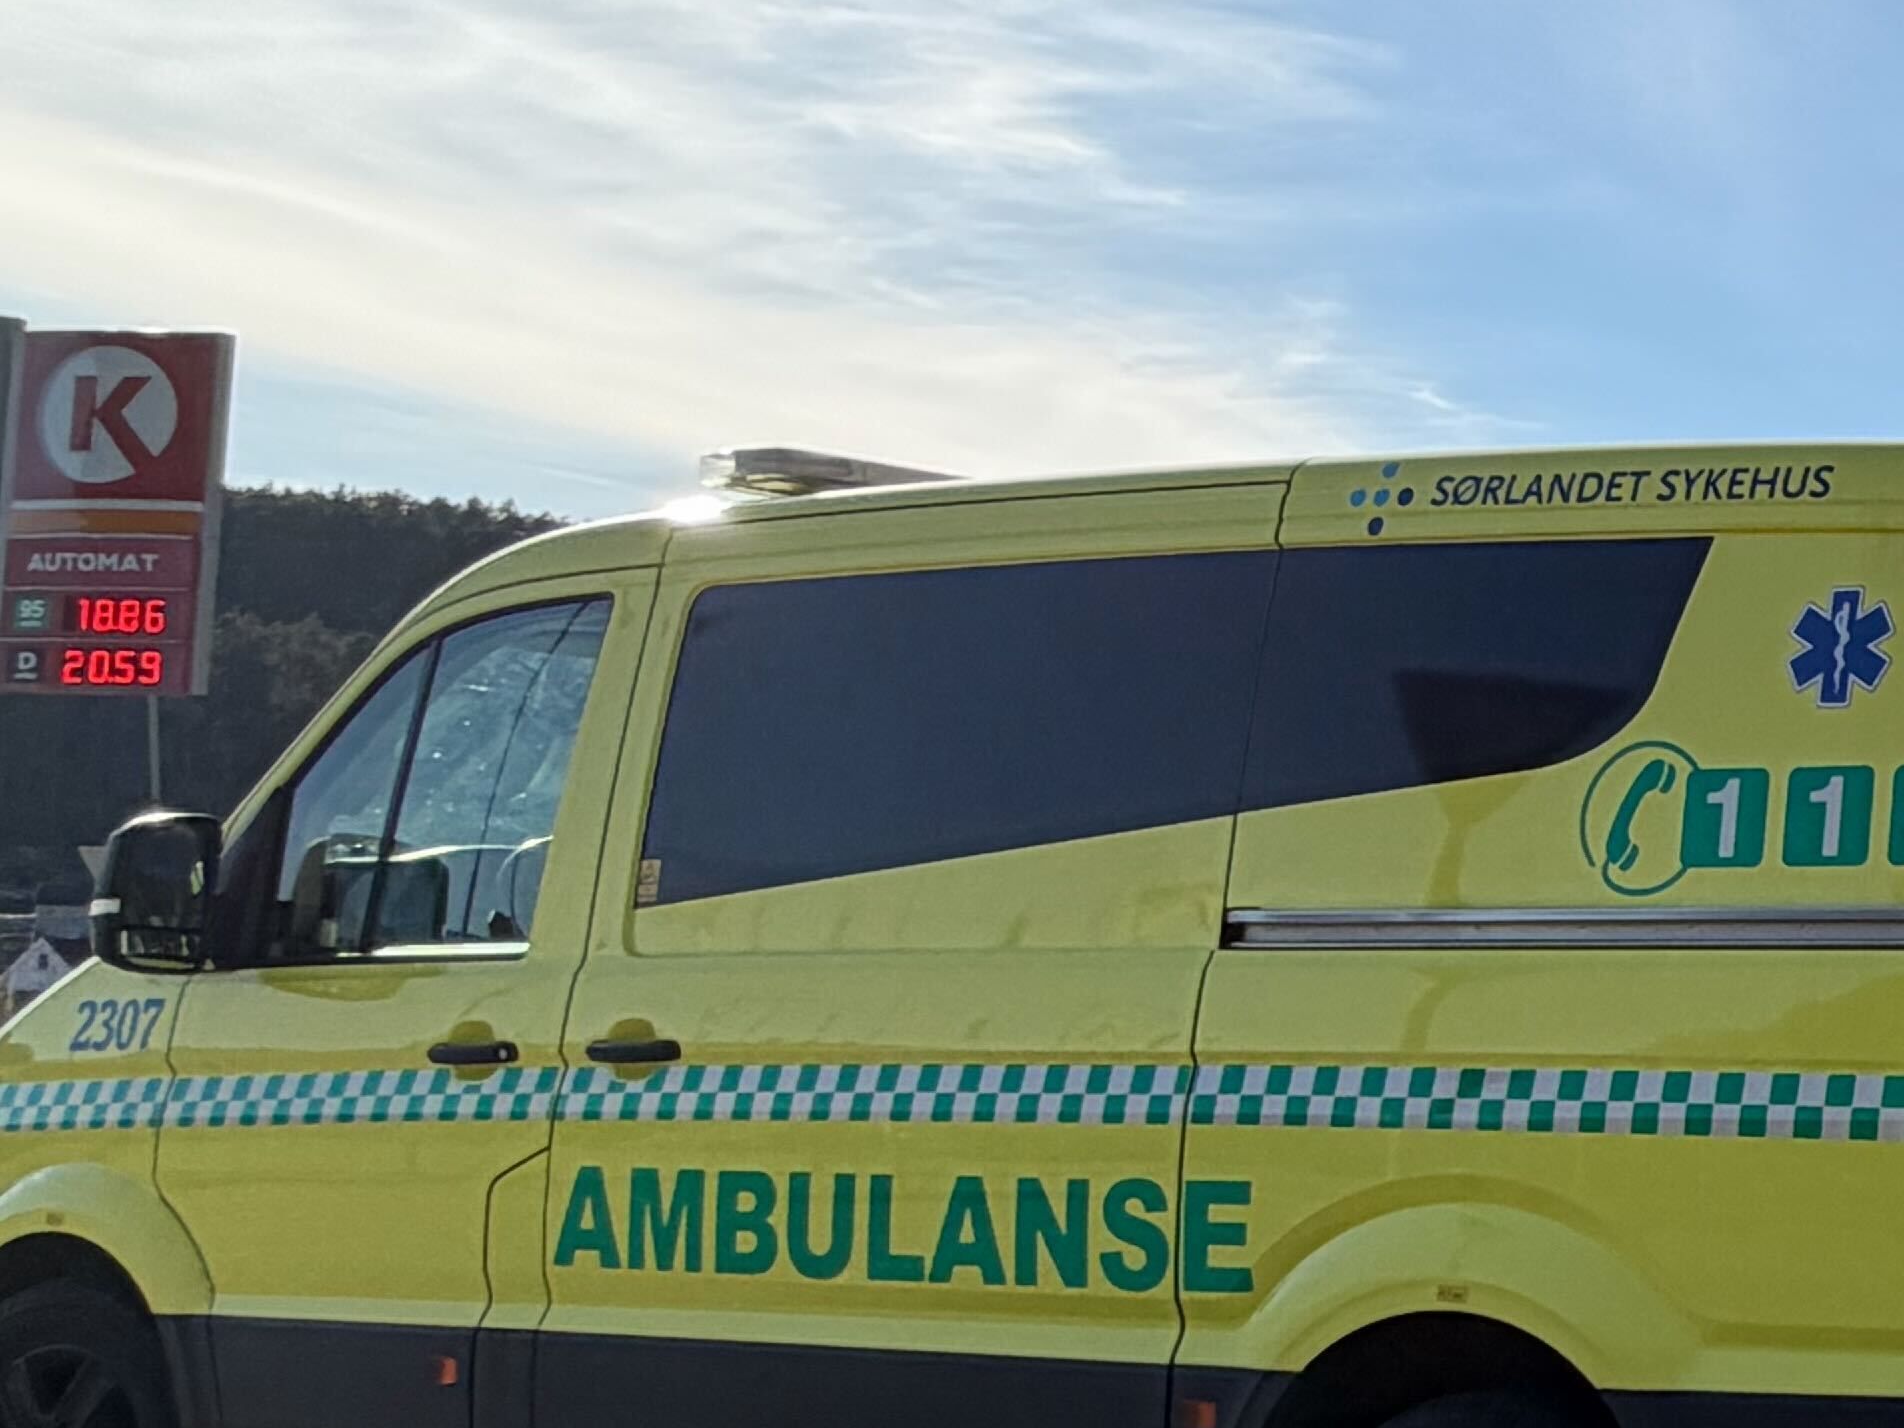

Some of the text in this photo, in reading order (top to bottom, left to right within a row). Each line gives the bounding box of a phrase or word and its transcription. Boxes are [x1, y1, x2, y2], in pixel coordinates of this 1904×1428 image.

[1430, 464, 1836, 506] SØRLANDET SYKEHUS
[27, 551, 160, 573] AUTOMAT
[19, 599, 47, 618] 95
[17, 651, 37, 670] D
[69, 997, 167, 1053] 2307
[553, 1165, 1255, 1294] AMBULANSE
